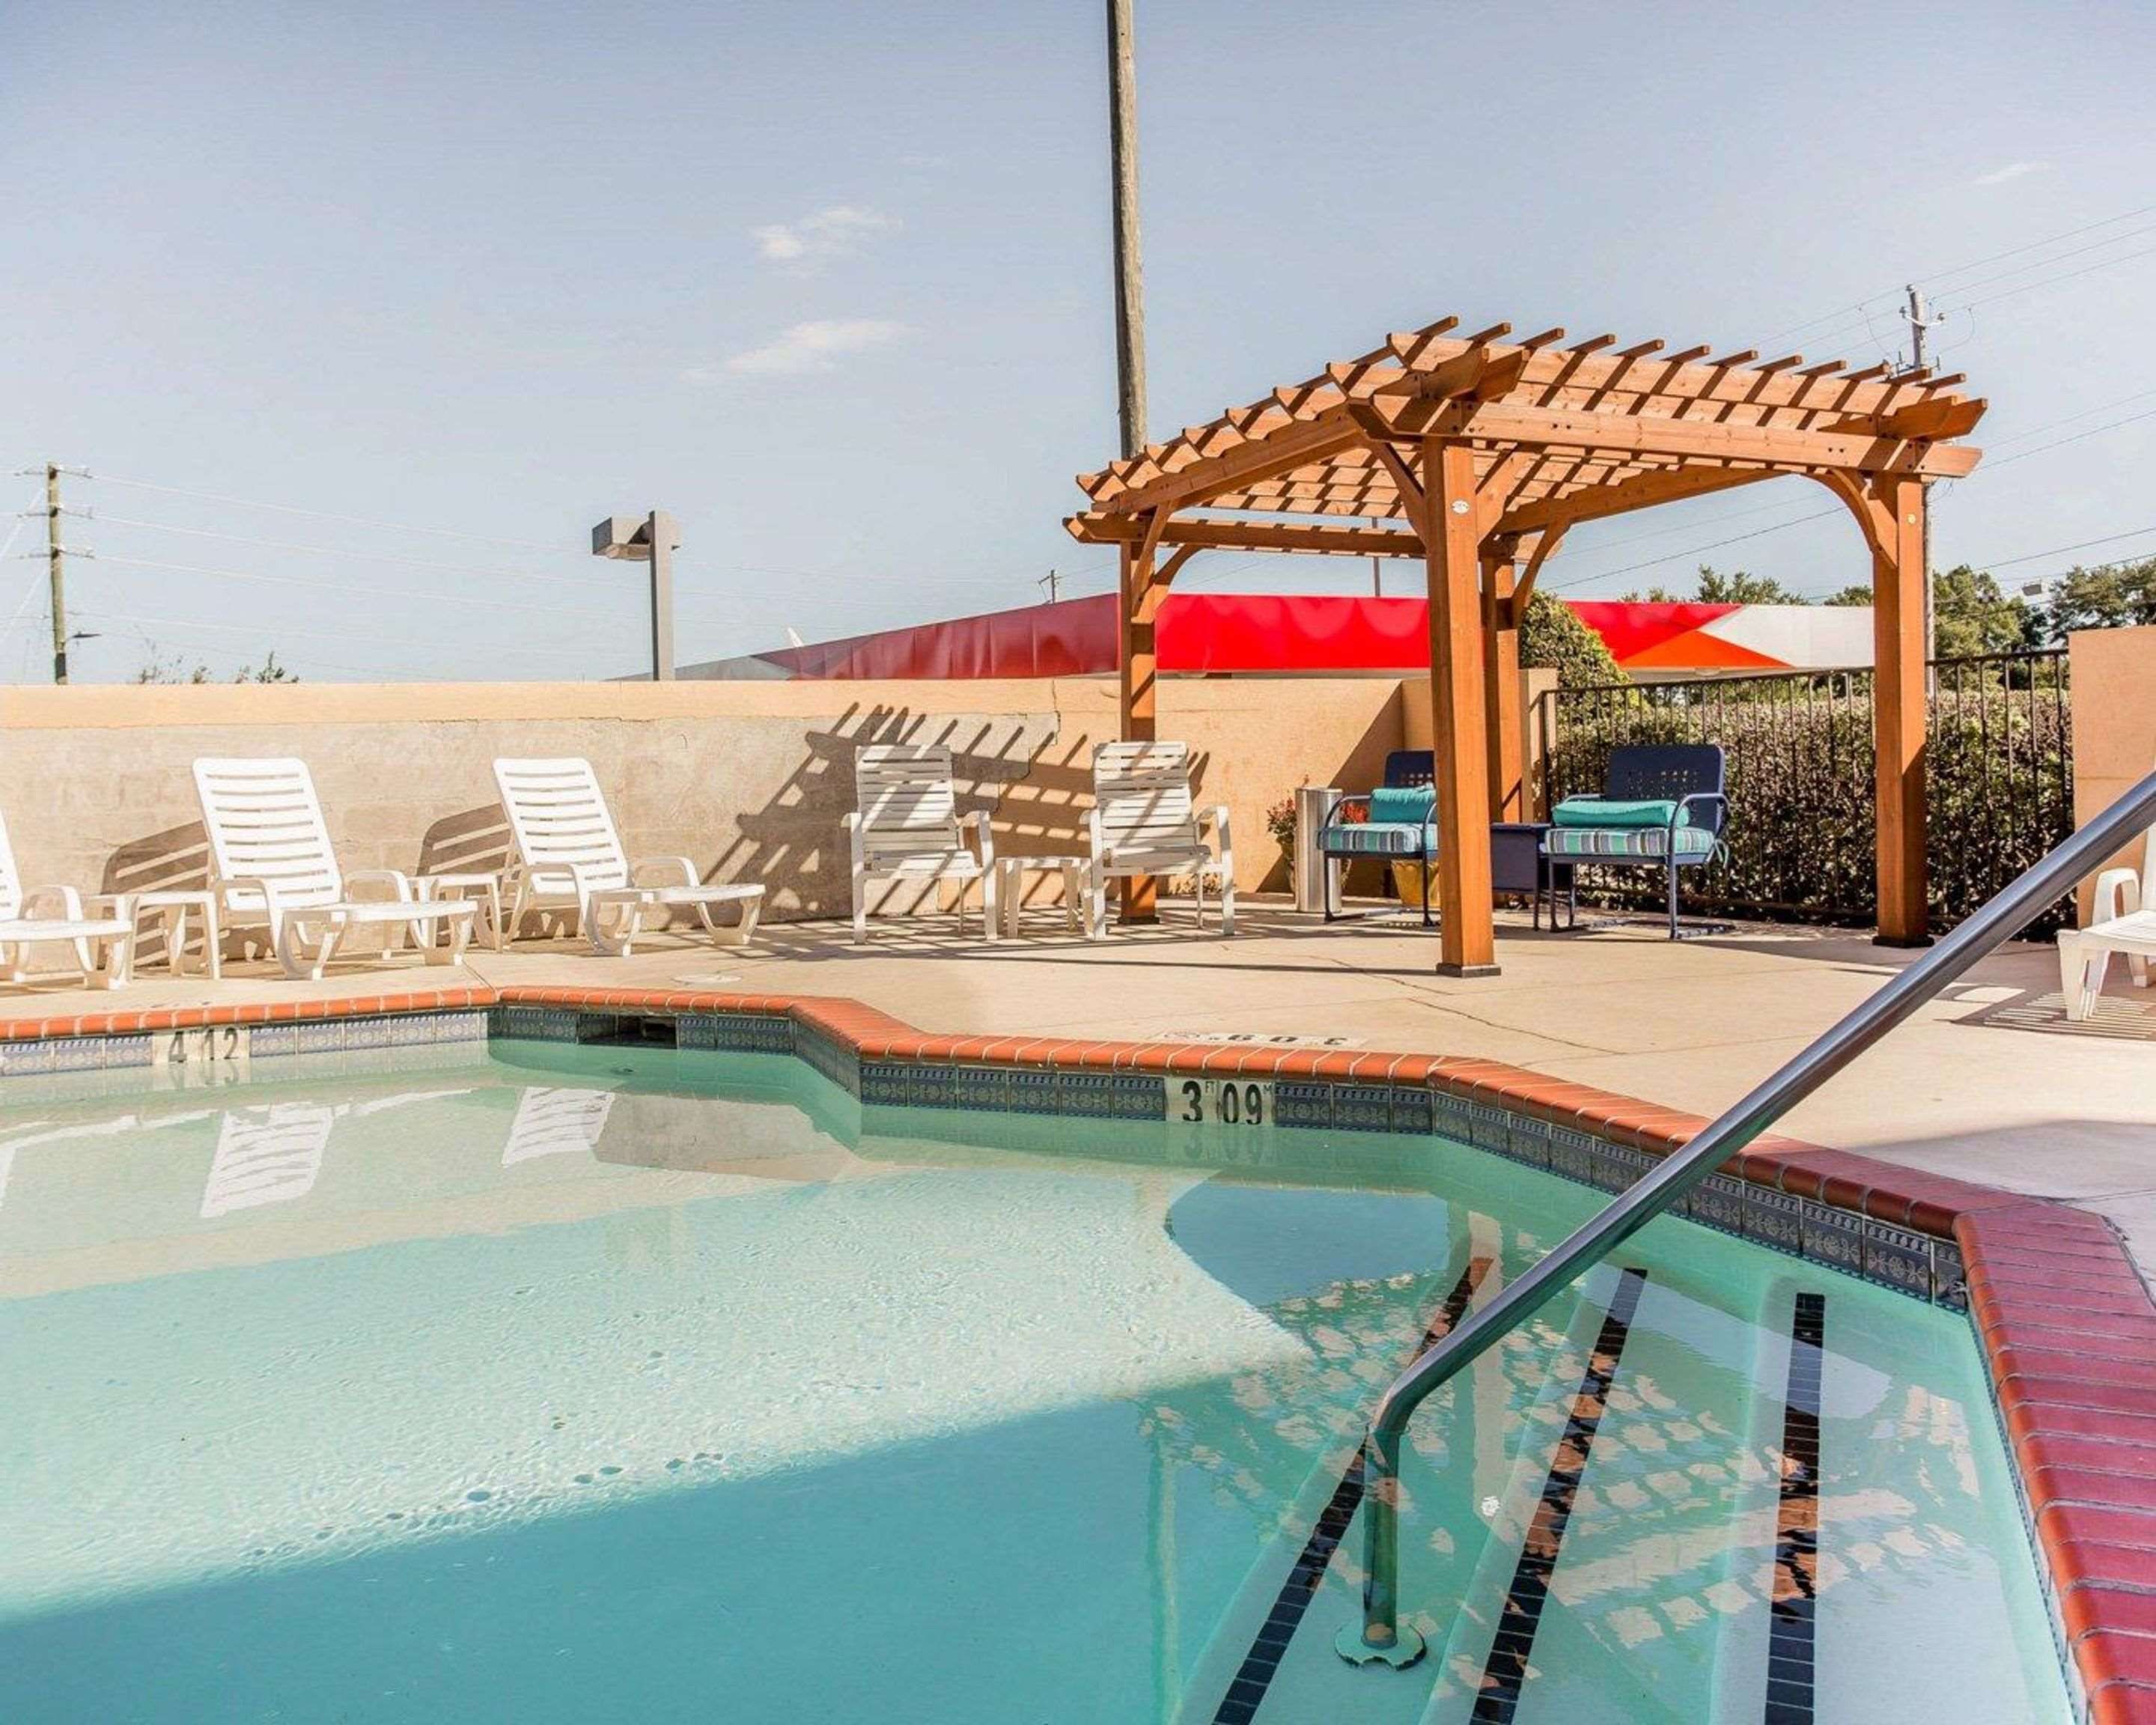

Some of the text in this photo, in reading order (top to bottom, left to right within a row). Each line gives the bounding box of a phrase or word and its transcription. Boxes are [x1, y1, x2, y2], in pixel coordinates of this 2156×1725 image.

[168, 1030, 187, 1063] 4
[1182, 1080, 1203, 1122] 3
[1222, 1083, 1262, 1125] 09
